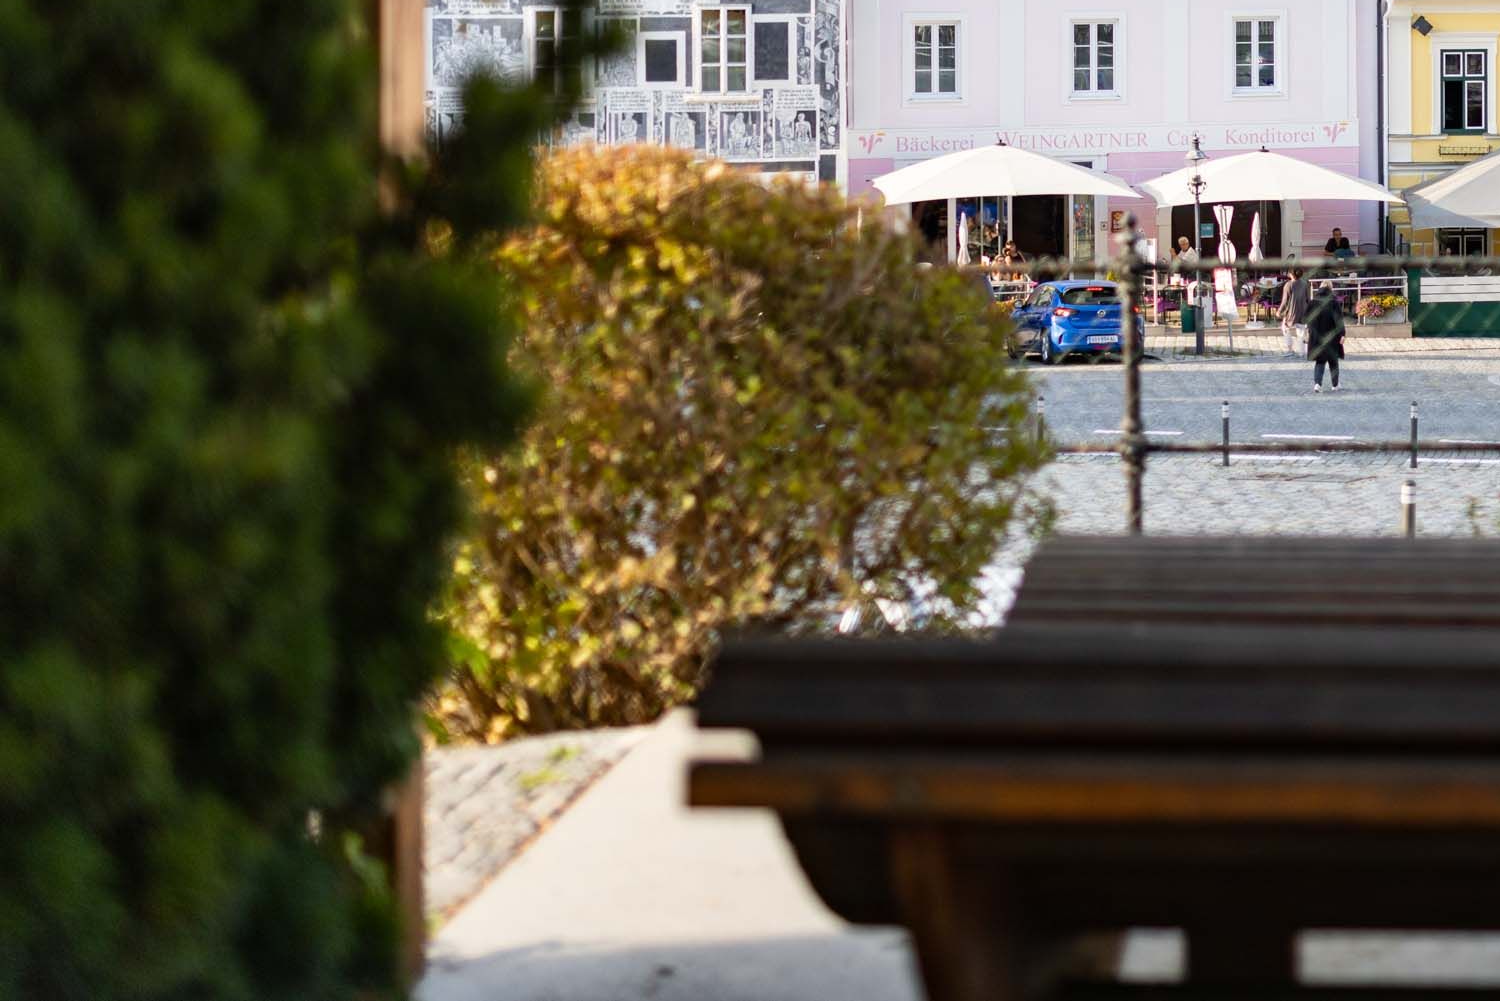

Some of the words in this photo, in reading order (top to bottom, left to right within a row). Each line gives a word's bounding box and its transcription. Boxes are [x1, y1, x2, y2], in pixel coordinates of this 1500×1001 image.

[896, 134, 975, 152] Bäckerei
[995, 131, 1149, 150] WEINGARTNER
[1167, 129, 1206, 147] Cae
[1225, 126, 1316, 145] Konditorei
